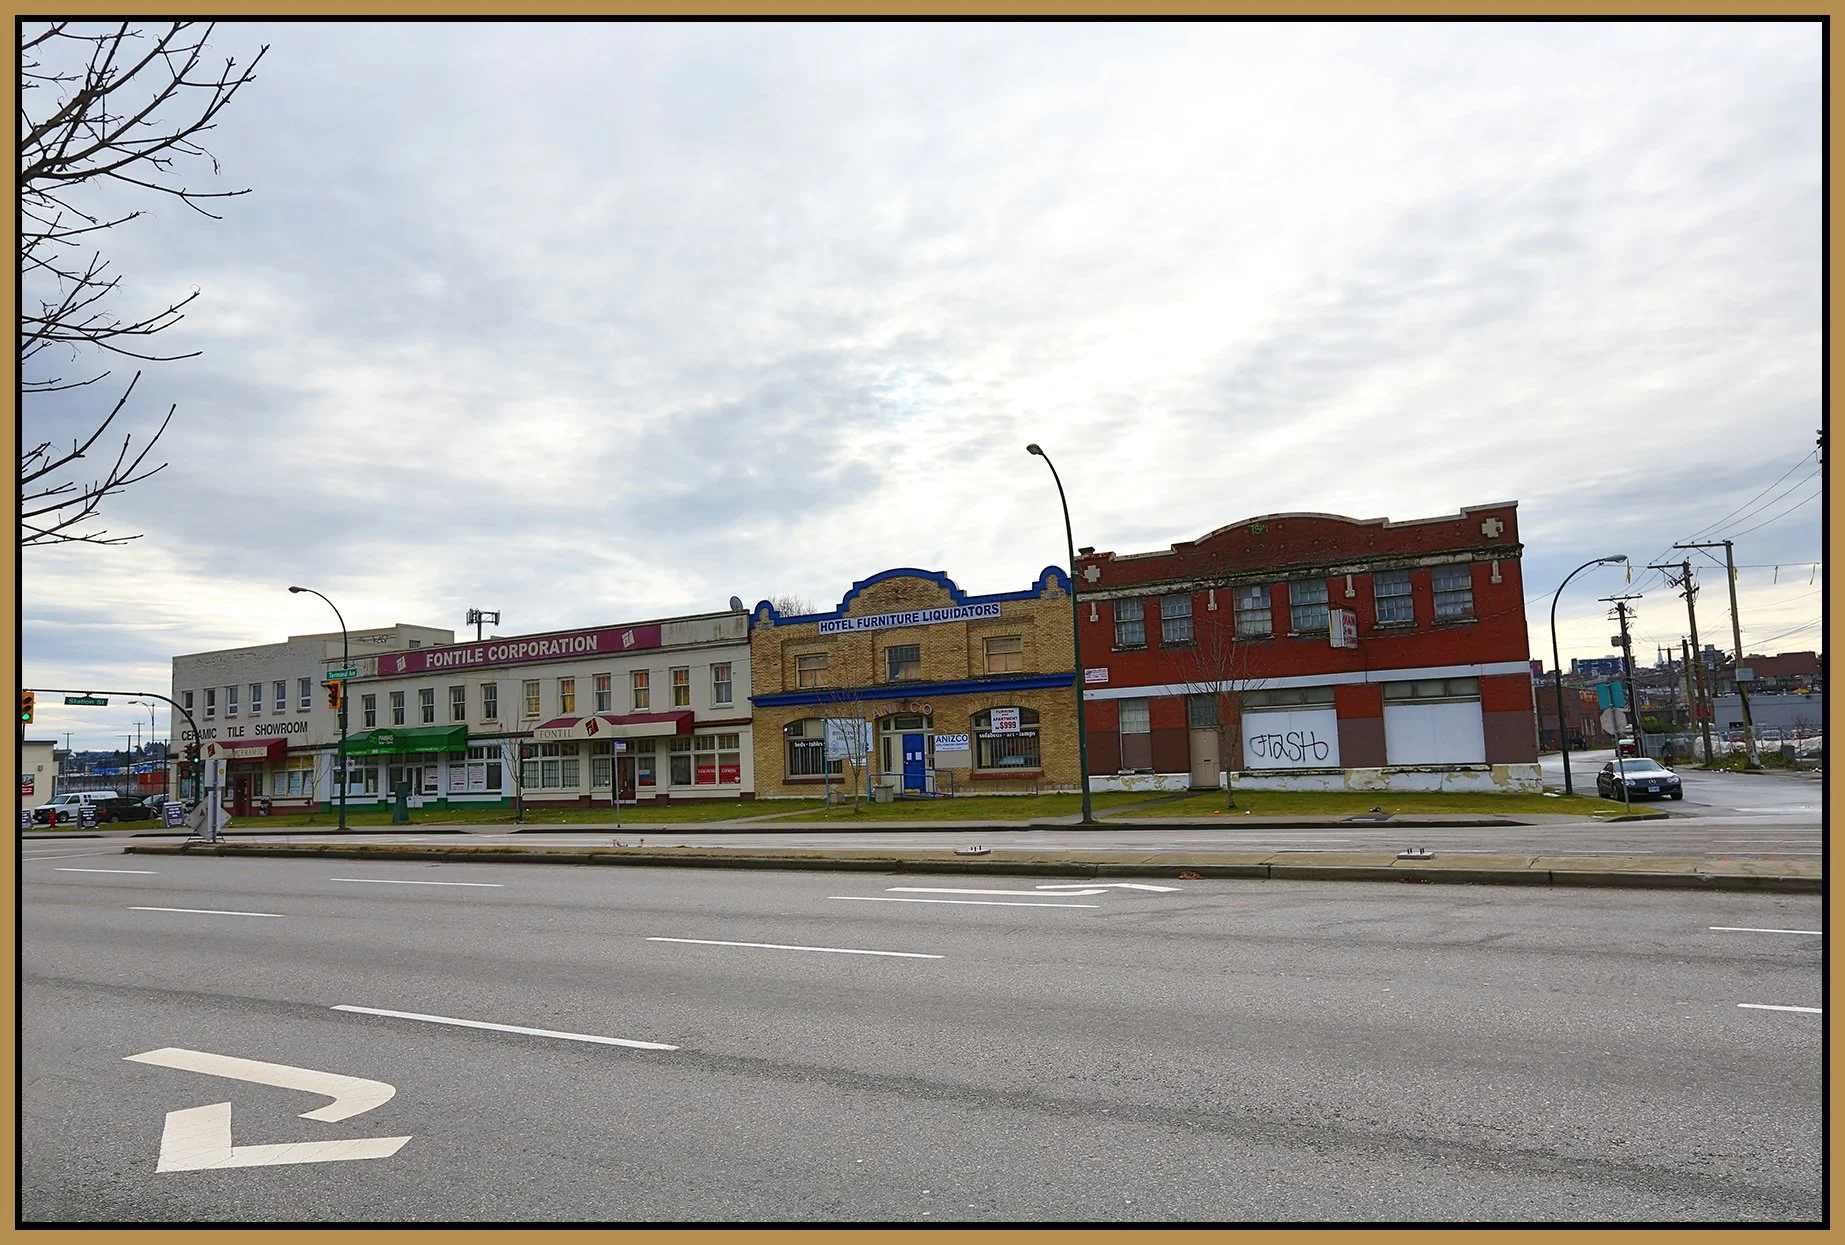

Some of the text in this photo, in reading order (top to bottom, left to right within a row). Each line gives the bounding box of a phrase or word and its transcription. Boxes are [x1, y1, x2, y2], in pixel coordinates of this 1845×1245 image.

[820, 603, 999, 632] HOTEL FURNITURE LIQUIDATORS
[426, 635, 597, 667] FONTILE CORPORATION
[68, 697, 95, 705] Station
[872, 701, 933, 719] ANIZCO
[181, 721, 308, 741] CERAMIC TILE SHOWROOM
[999, 721, 1017, 730] $999
[936, 734, 968, 743] ANIZCO
[237, 748, 265, 757] CERAMIC
